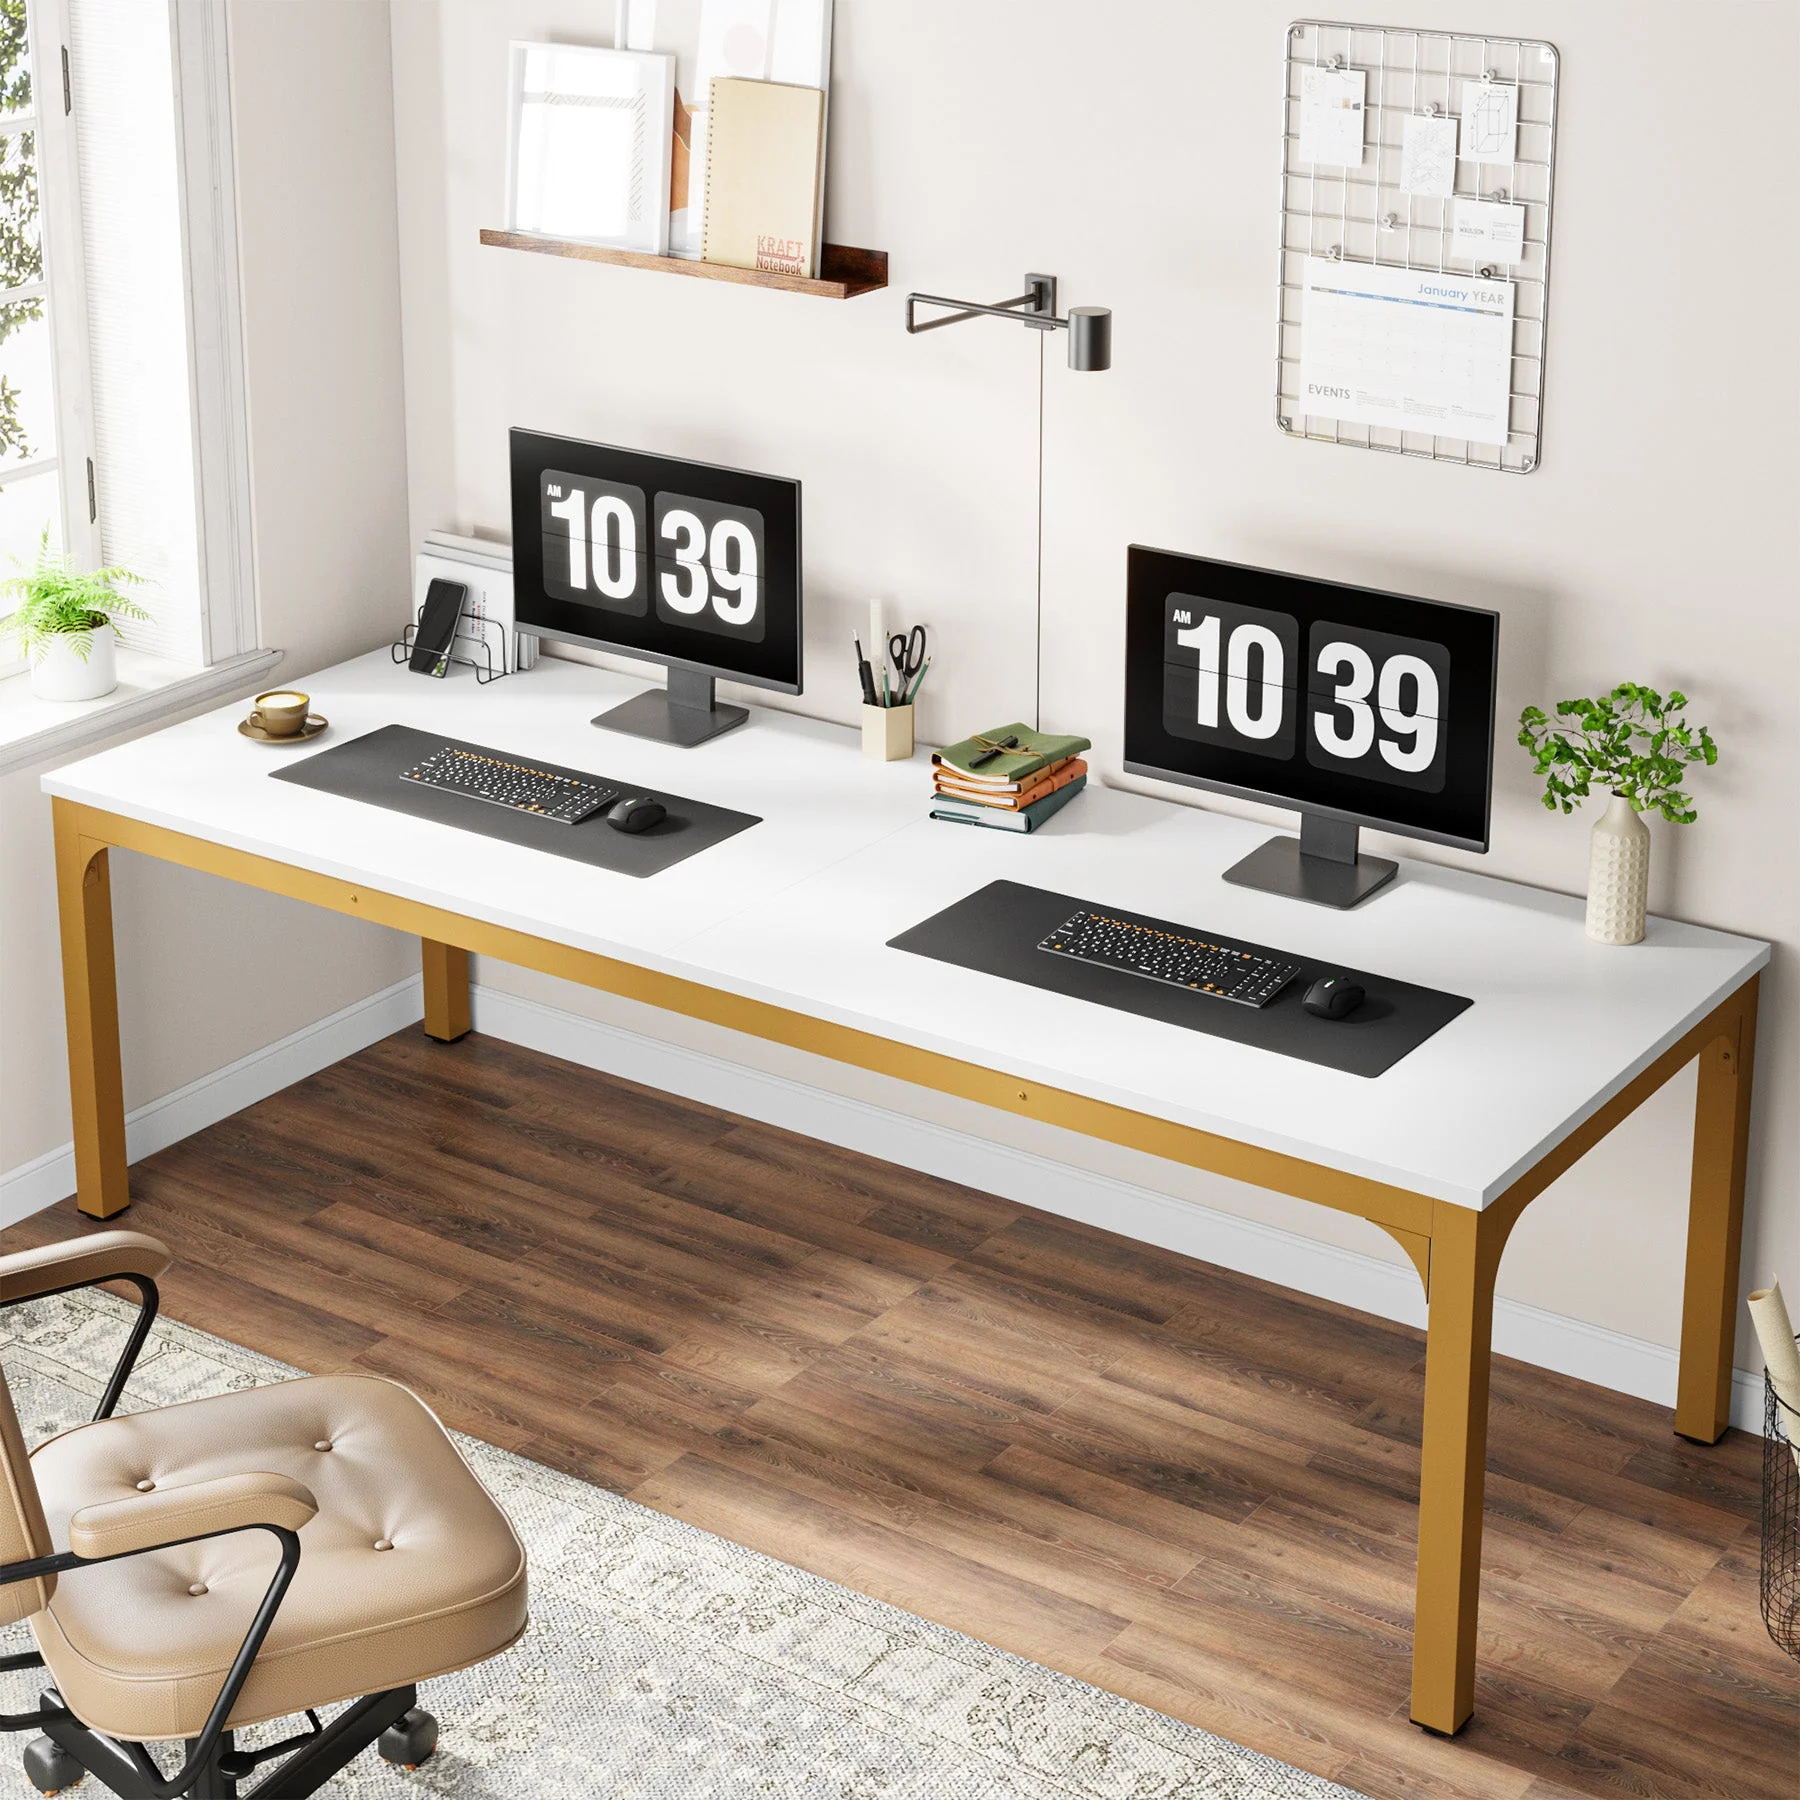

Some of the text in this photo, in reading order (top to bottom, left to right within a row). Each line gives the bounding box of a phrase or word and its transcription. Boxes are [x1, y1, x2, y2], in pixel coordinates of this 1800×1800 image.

[757, 235, 803, 259] KRAFT
[756, 256, 802, 275] Notebook
[1417, 284, 1505, 305] January YEAR
[1308, 383, 1351, 400] EVENTS
[547, 484, 562, 498] AM
[551, 489, 758, 625] 10 39
[1173, 609, 1192, 625] AM
[1177, 615, 1439, 773] 10 39
